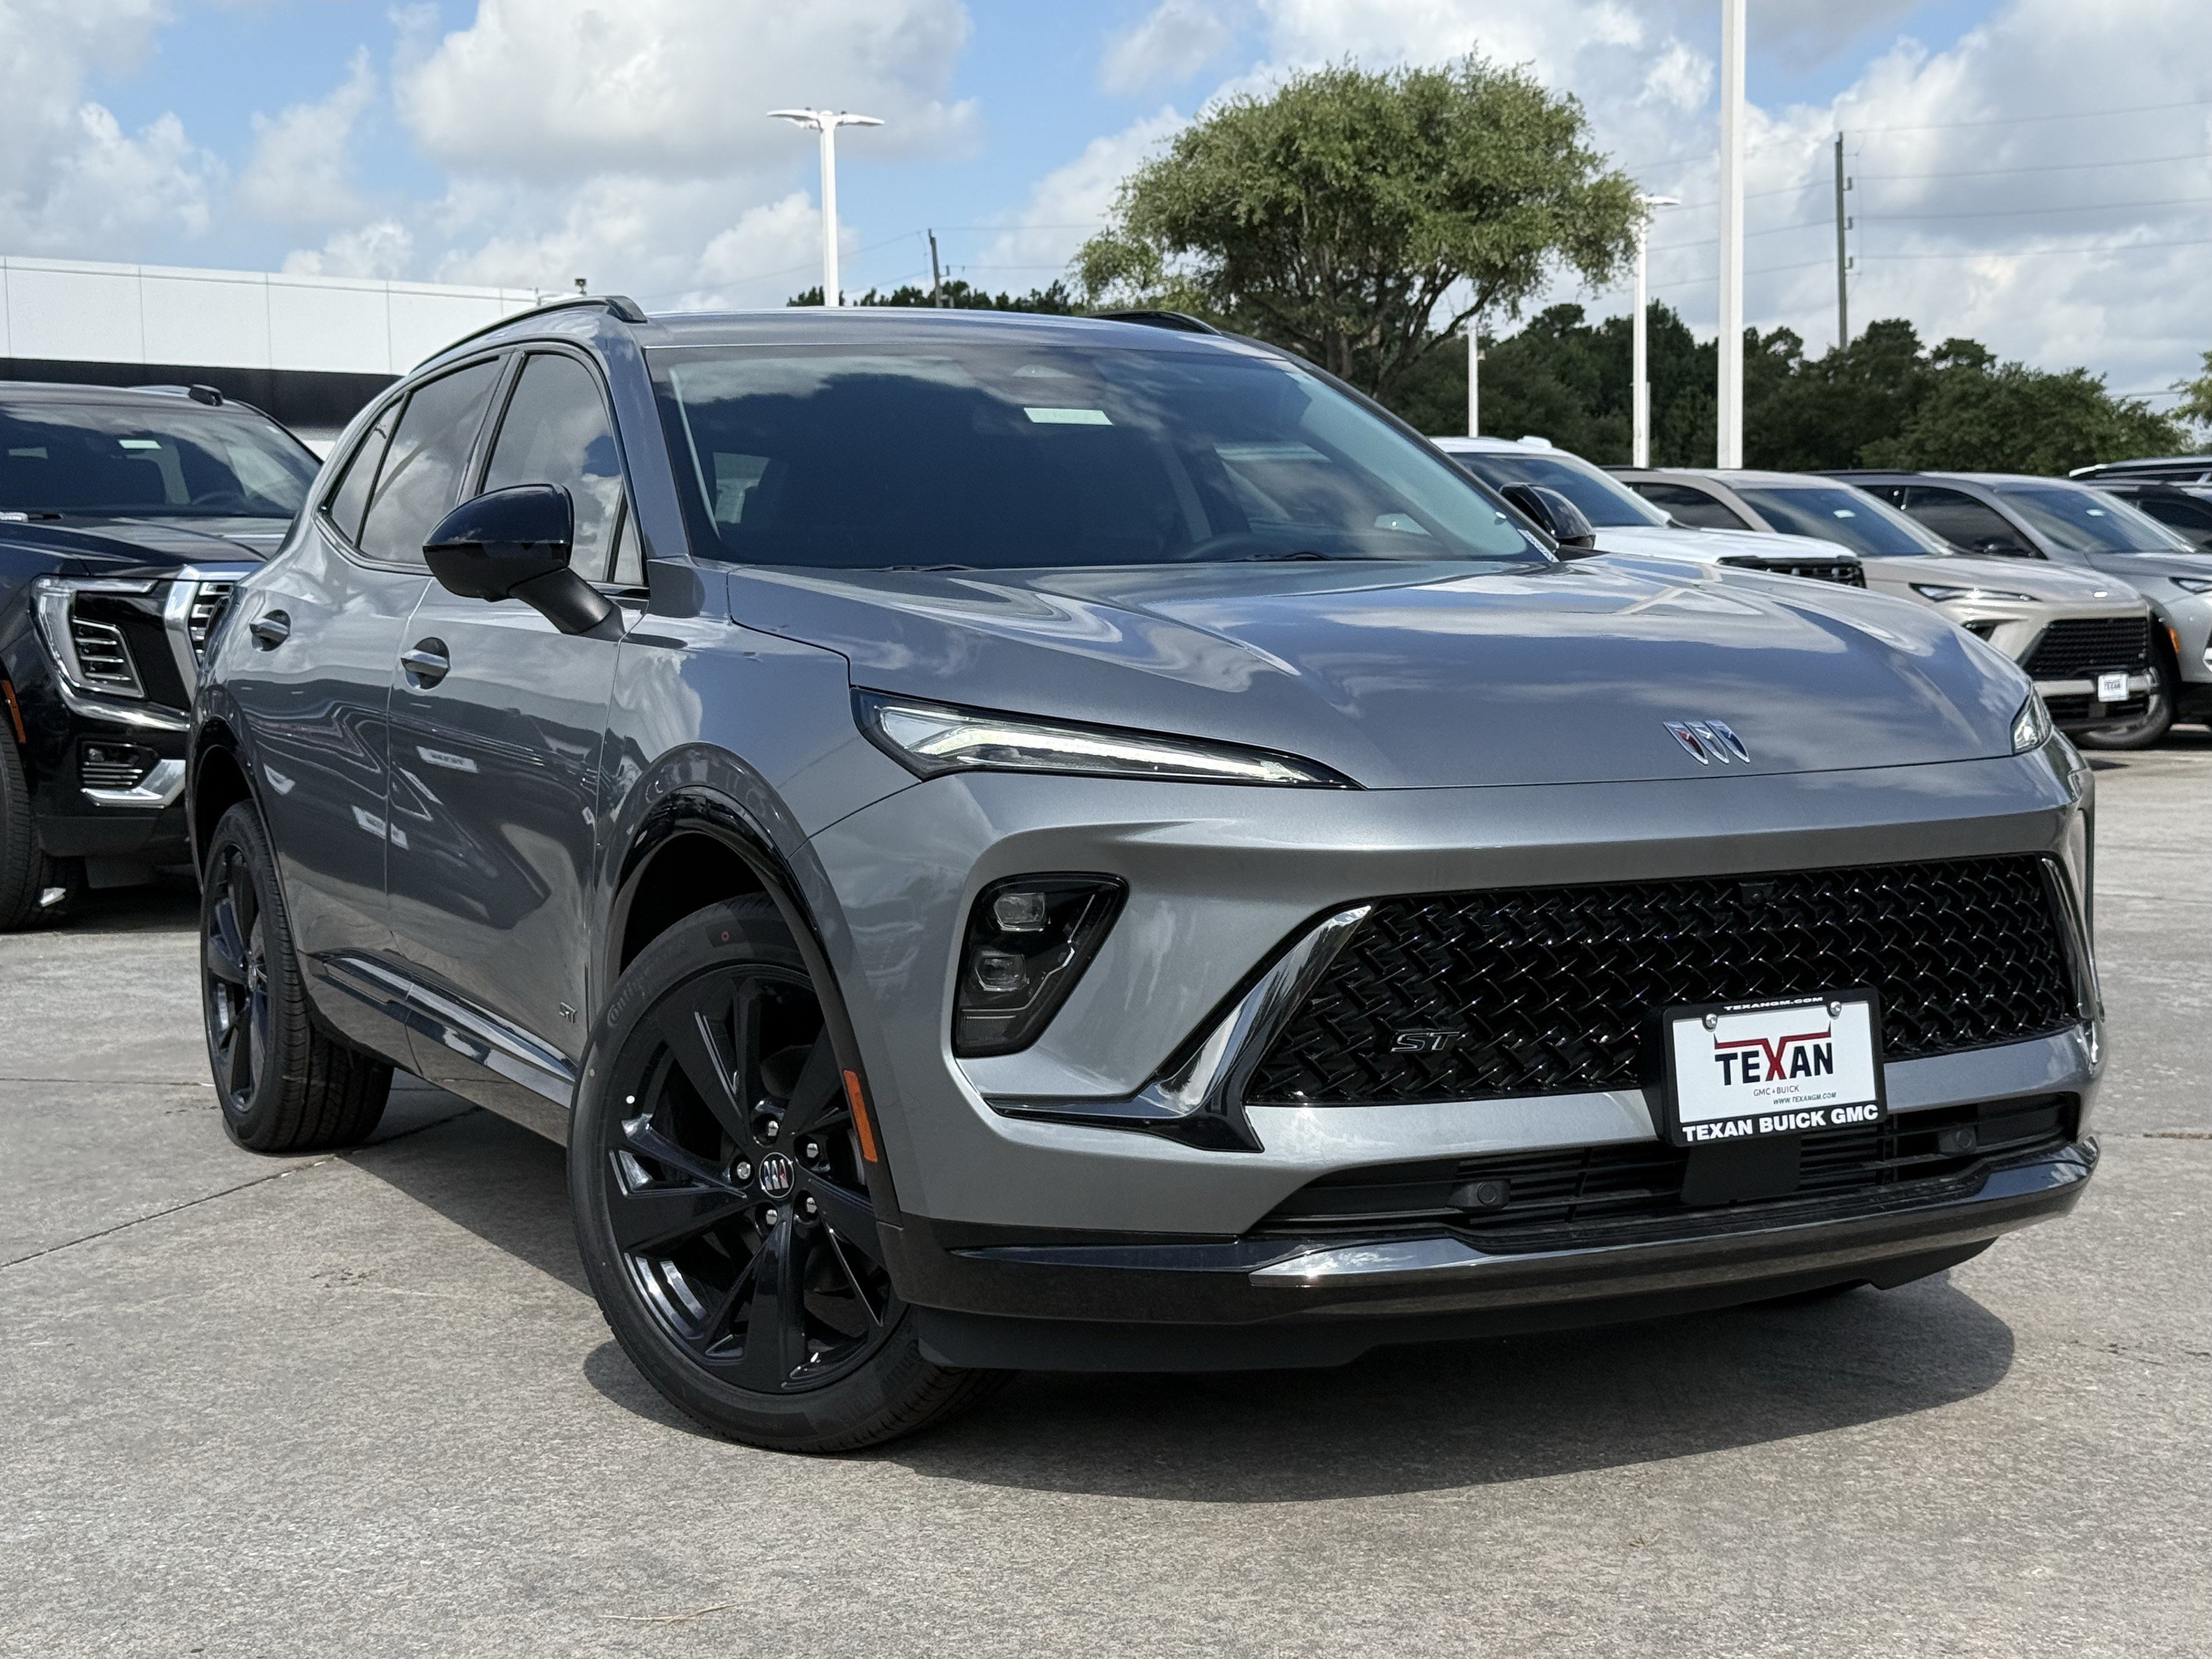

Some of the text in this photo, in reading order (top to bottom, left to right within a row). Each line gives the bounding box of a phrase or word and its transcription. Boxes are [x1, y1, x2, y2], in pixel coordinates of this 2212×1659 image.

[1724, 997, 1823, 1011] TEXANGM.COM
[1391, 1031, 1460, 1053] ST
[1714, 1037, 1833, 1086] TEXAN
[1753, 1085, 1799, 1097] GMC BUICK
[1682, 1104, 1879, 1142] TEXAN BUICK GMC
